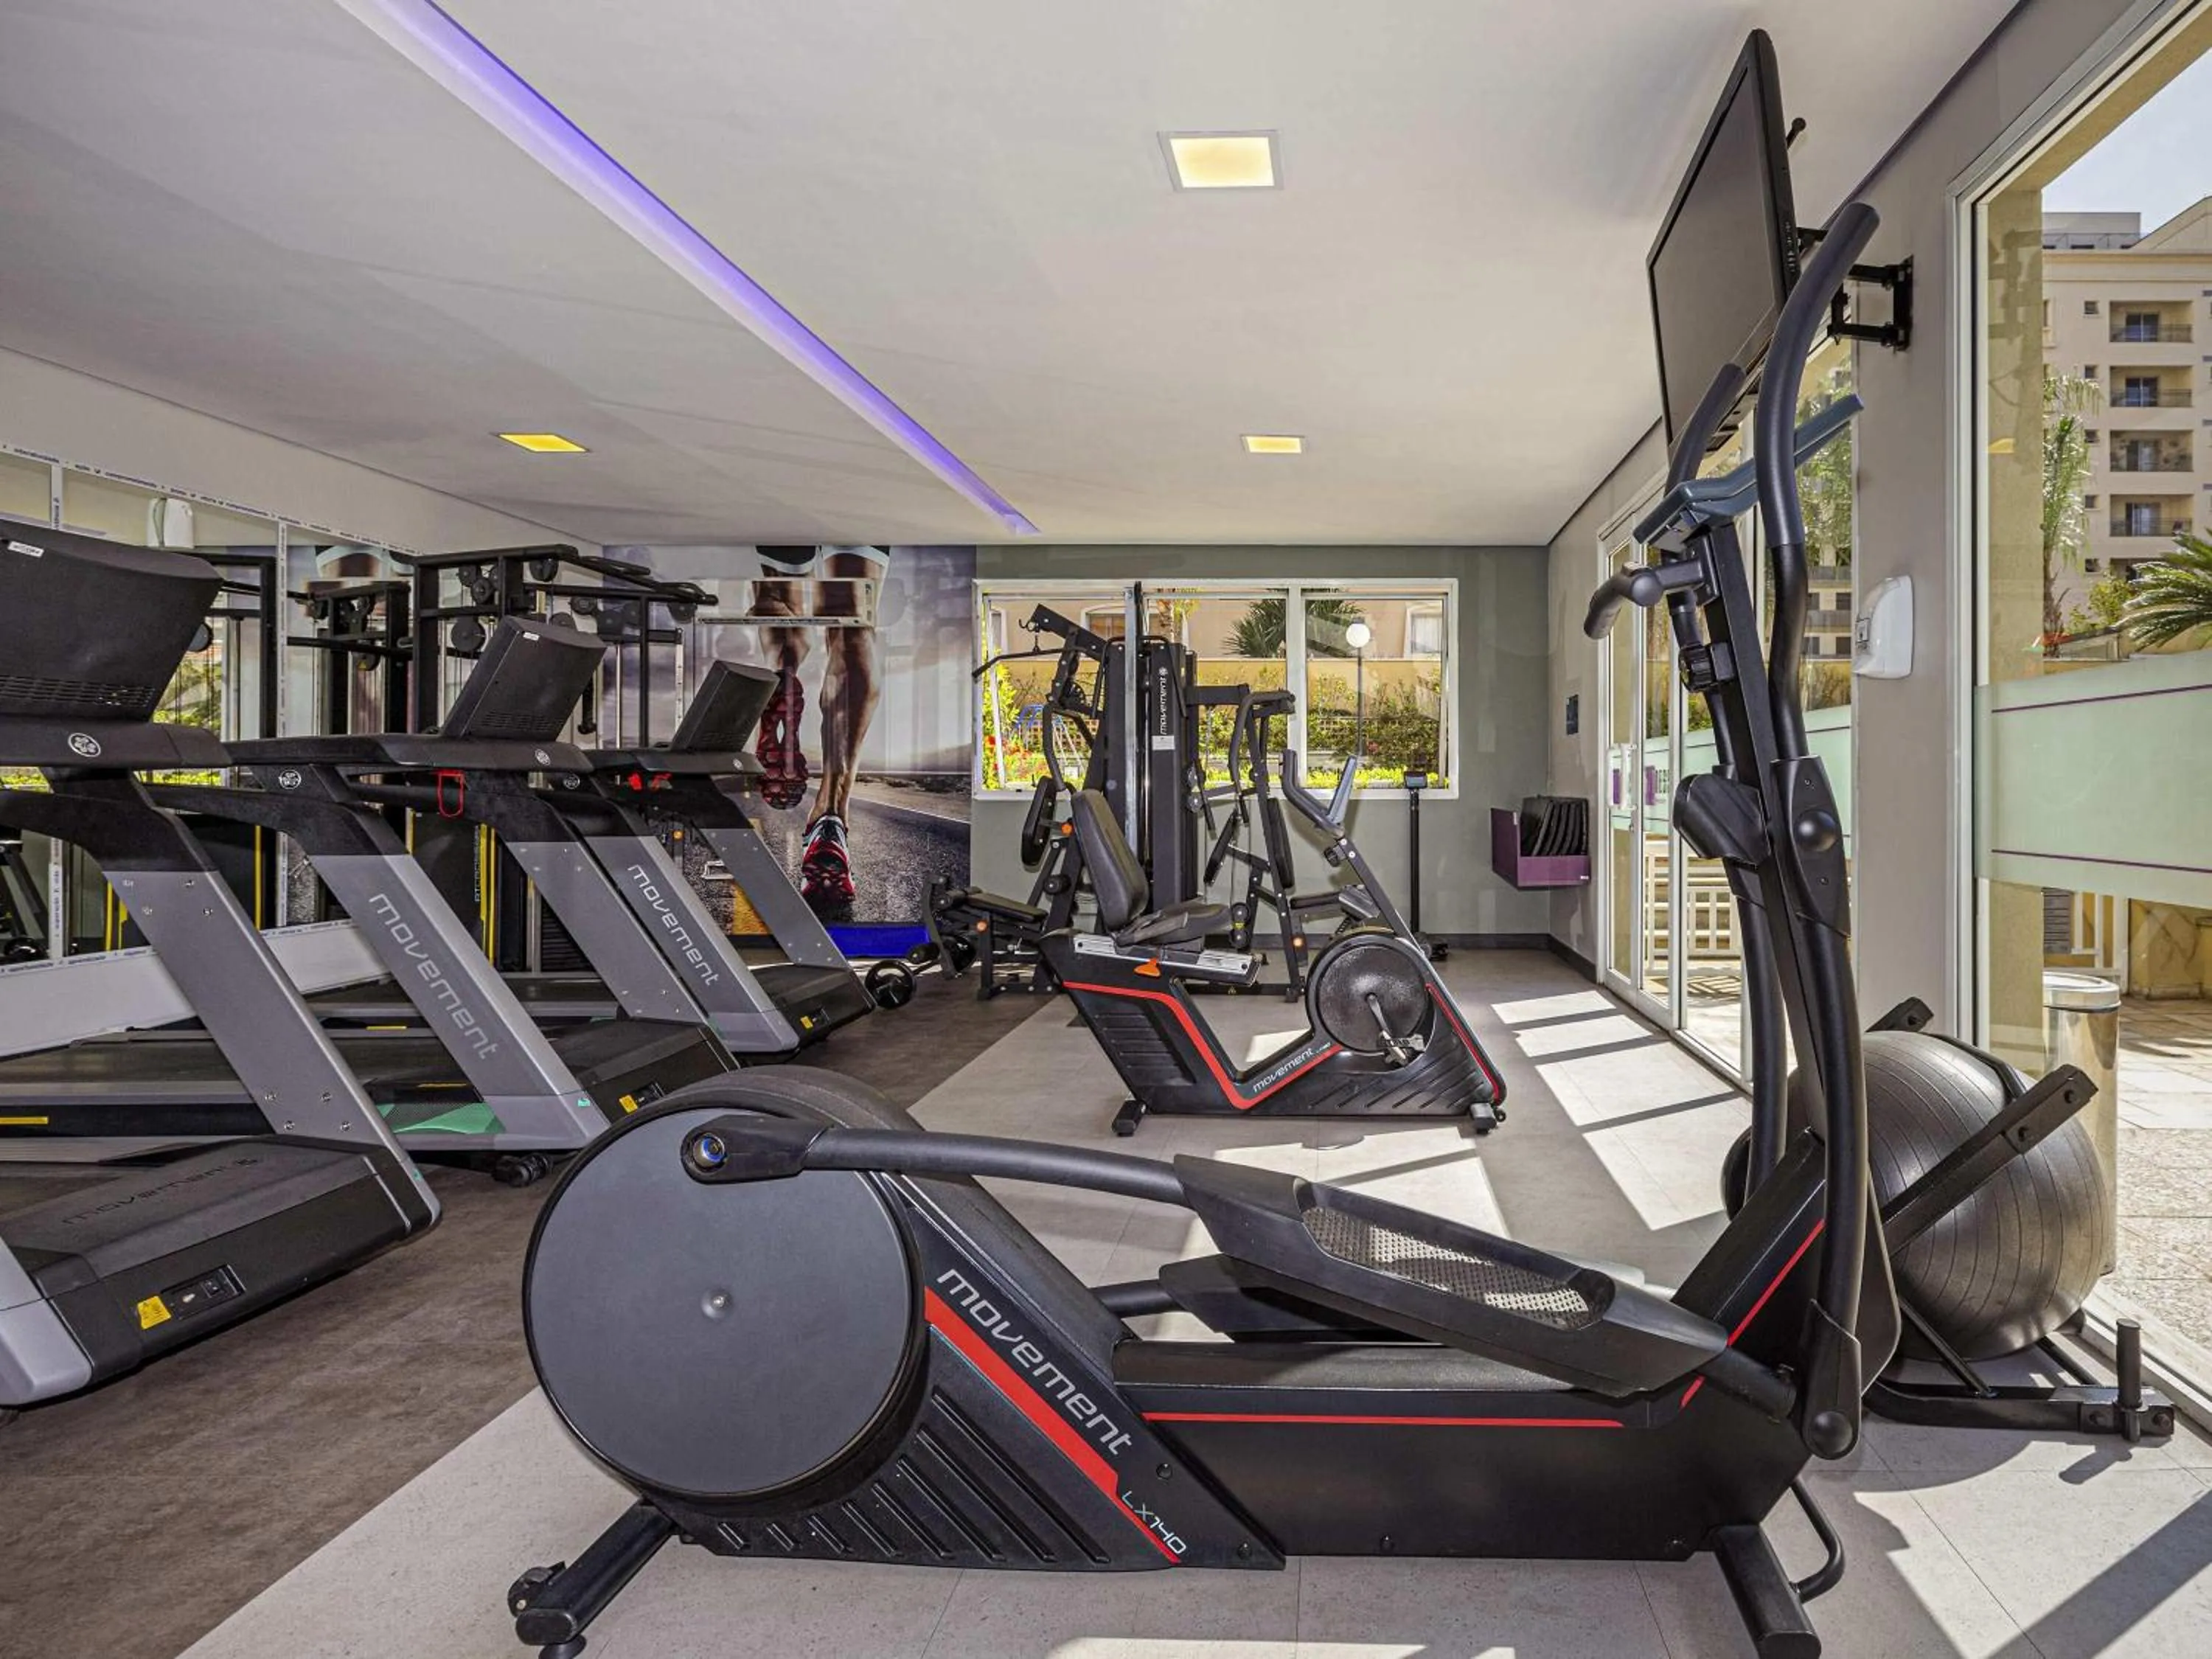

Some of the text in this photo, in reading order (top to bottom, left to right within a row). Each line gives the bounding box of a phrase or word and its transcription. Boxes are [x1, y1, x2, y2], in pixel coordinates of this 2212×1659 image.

[369, 893, 498, 1059] movement
[627, 864, 719, 985] movement
[1253, 1048, 1314, 1092] movement
[936, 1268, 1132, 1455] movement
[1121, 1491, 1186, 1554] LX140
